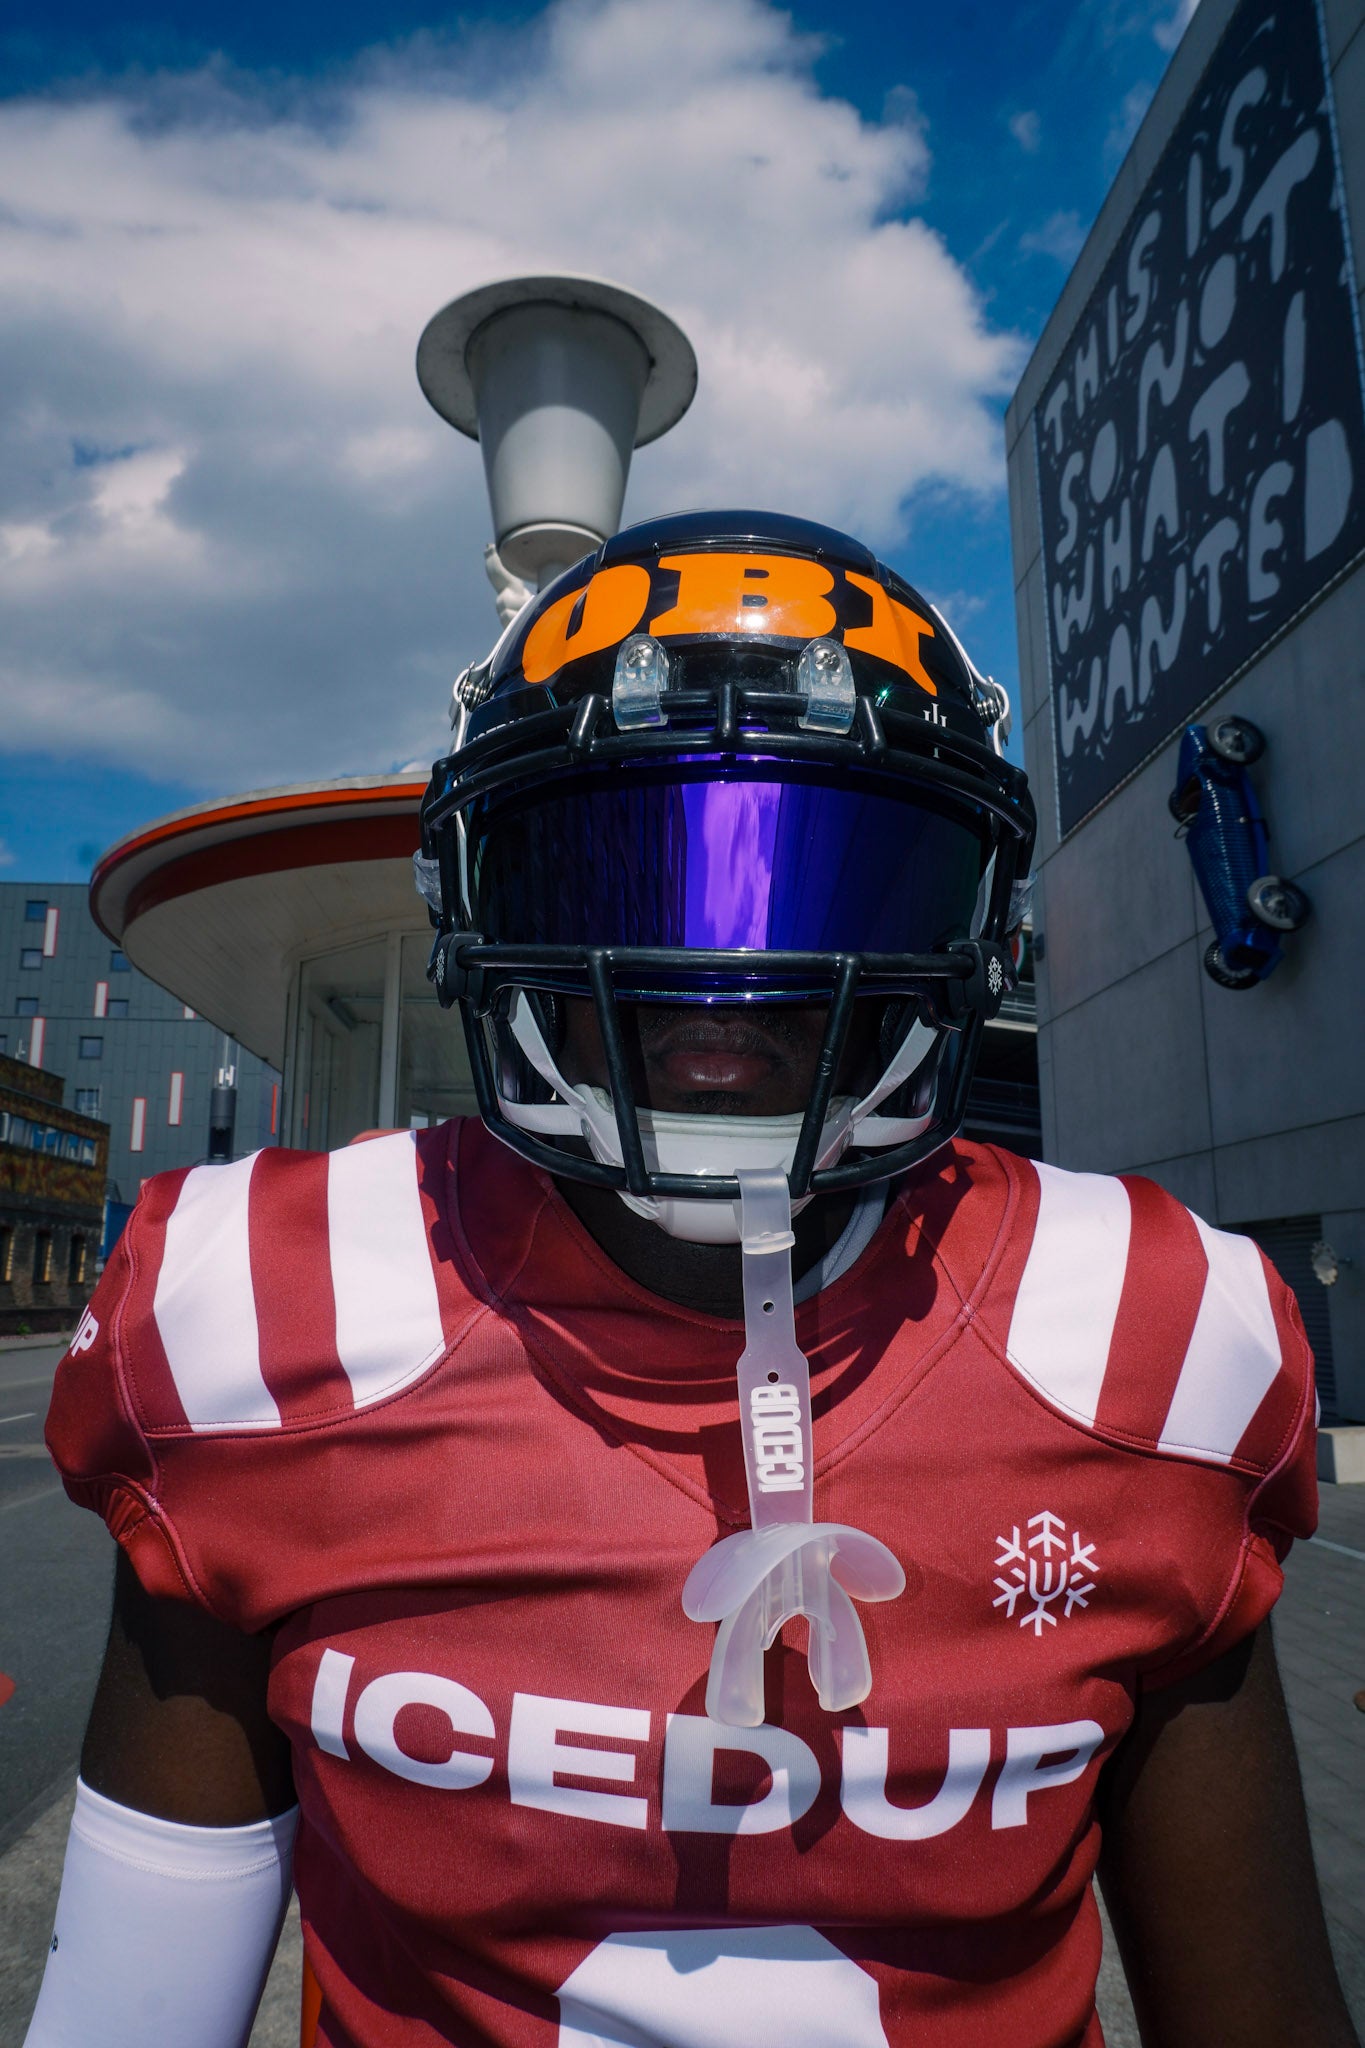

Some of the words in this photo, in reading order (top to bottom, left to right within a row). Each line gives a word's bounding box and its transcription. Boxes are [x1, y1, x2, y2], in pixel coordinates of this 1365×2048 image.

[1044, 210, 1162, 455] THIS
[1186, 65, 1268, 259] IS
[1055, 419, 1118, 563] SO
[1137, 126, 1320, 461] NOT
[522, 553, 938, 696] OBI
[1053, 361, 1250, 655] WHAT
[1282, 290, 1306, 424] I
[1060, 418, 1353, 758] WANTED
[311, 1648, 1105, 1841] ICEDUP
